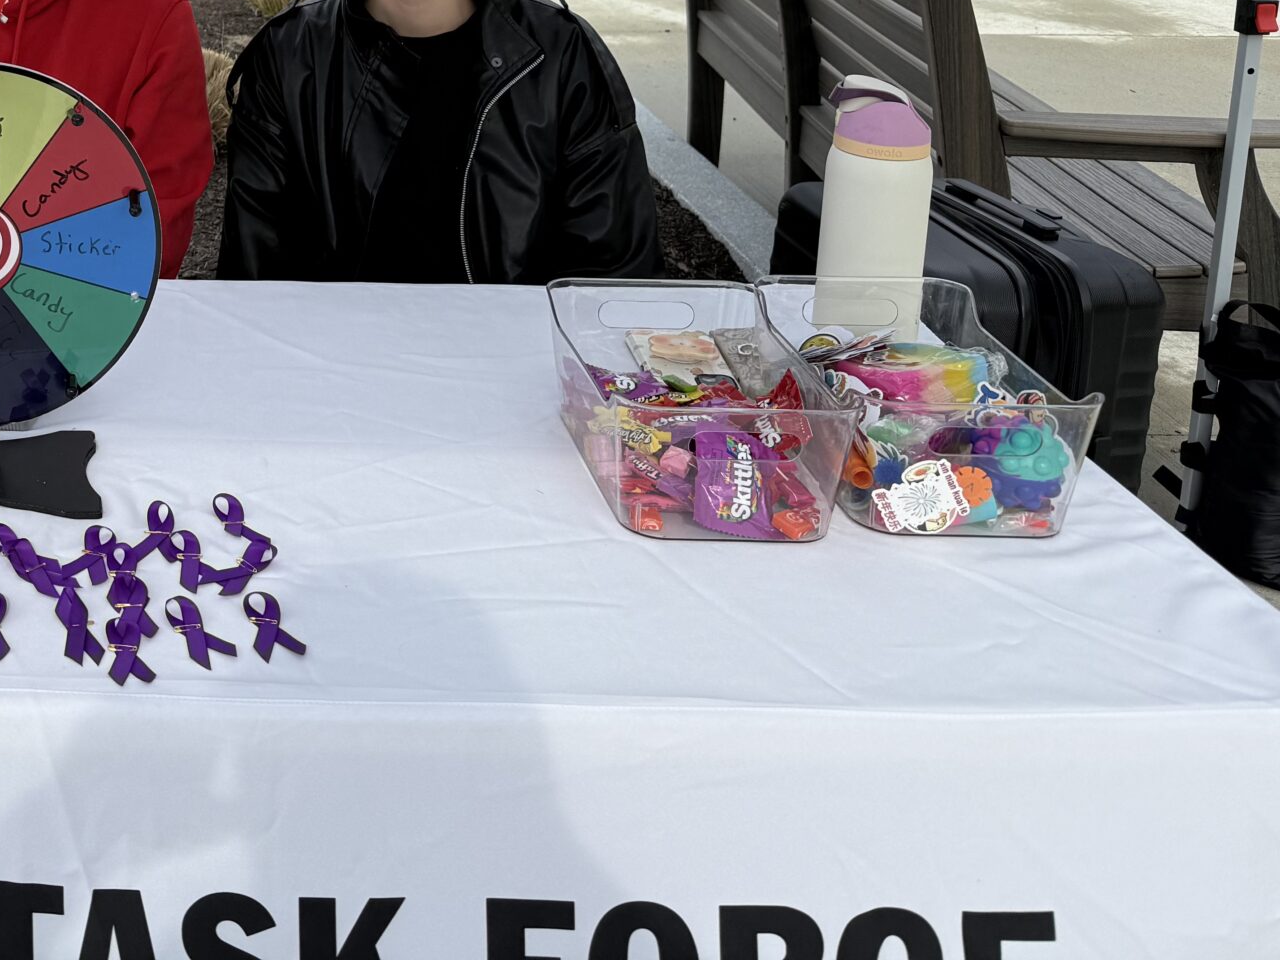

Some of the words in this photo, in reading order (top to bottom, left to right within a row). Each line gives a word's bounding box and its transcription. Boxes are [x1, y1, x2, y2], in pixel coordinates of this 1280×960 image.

[866, 146, 903, 158] owala
[22, 158, 90, 218] Candy
[41, 230, 121, 257] Sticker
[10, 272, 75, 333] Candy
[730, 442, 753, 521] Skittles
[875, 491, 902, 531] 新年快乐
